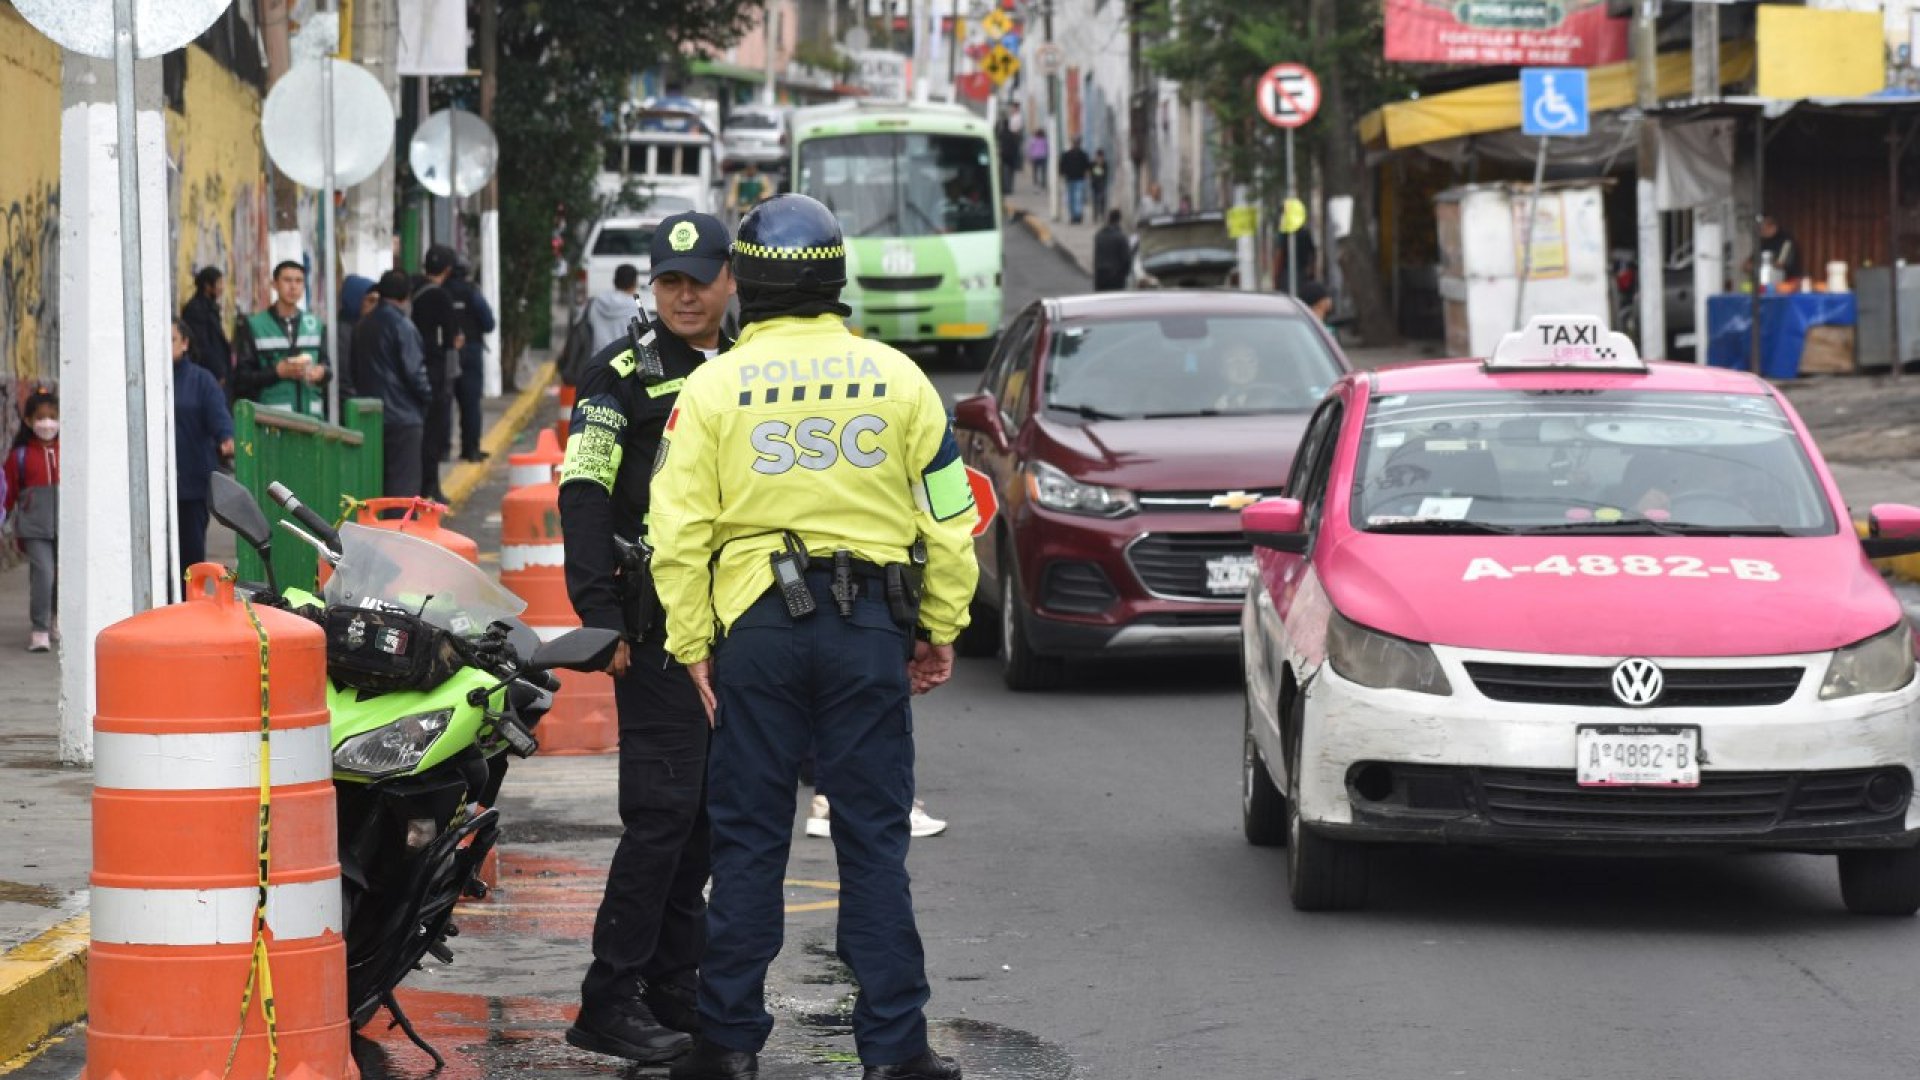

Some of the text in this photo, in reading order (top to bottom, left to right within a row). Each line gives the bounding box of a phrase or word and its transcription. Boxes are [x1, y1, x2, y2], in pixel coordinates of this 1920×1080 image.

[1538, 325, 1597, 345] TAXI
[739, 351, 882, 387] POLICÍA
[582, 405, 628, 427] TRANSITO
[750, 413, 889, 475] SSC
[1462, 554, 1781, 581] A-4882-B
